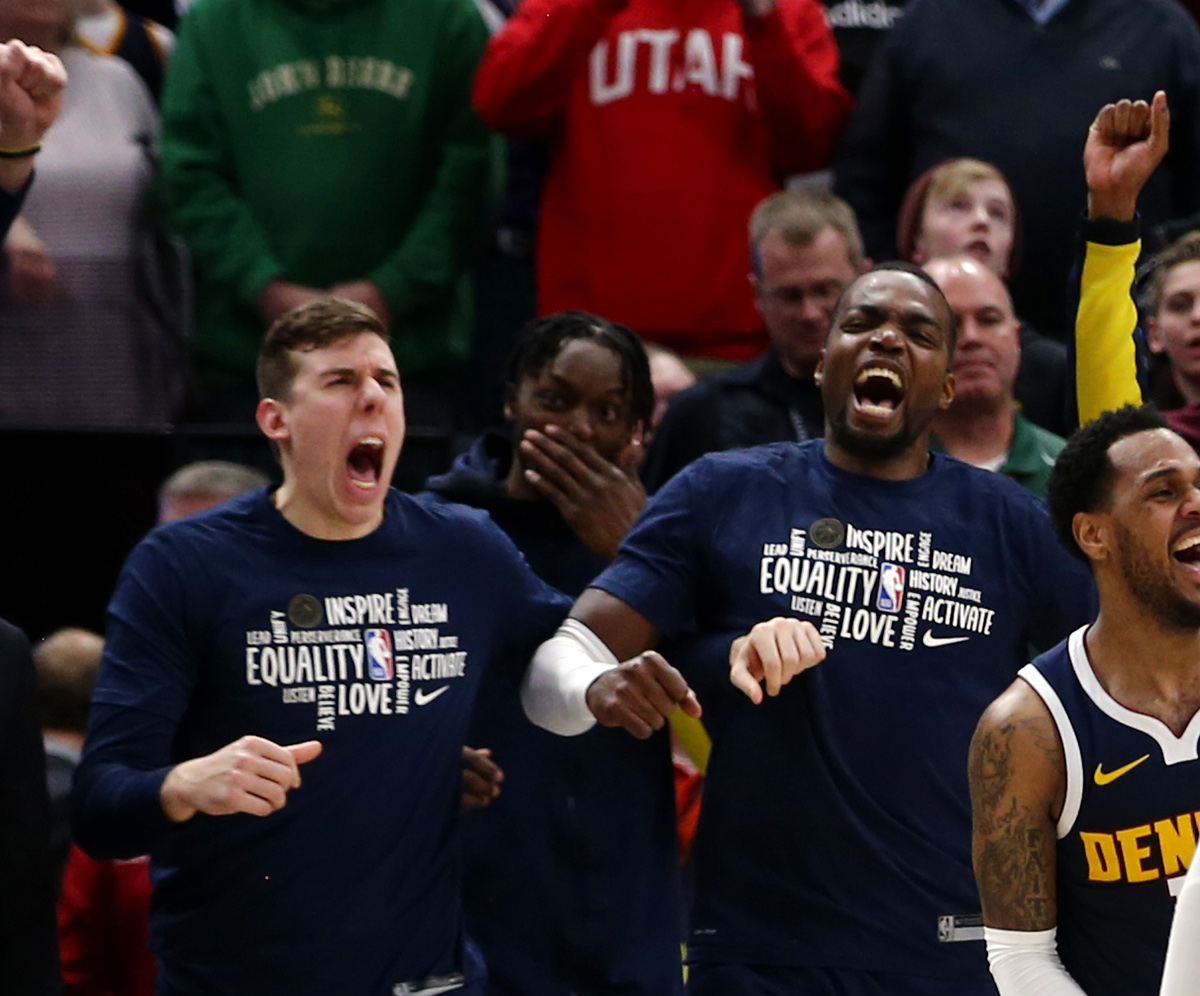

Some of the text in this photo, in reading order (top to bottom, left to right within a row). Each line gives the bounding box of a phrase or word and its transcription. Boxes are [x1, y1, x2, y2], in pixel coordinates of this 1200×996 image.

[763, 543, 788, 557] LEAD
[846, 523, 915, 563] INSPIRE
[932, 550, 971, 575] DREAM
[760, 557, 878, 607] EQUALITY
[909, 569, 958, 597] HISTORY
[325, 592, 396, 626] INSPIRE
[411, 603, 448, 624] DREAM
[791, 595, 823, 617] LISTEN
[899, 591, 922, 651] EMPOWER
[922, 596, 996, 635] ACTIVATE
[393, 628, 438, 651] HISTORY
[840, 607, 899, 648] LOVE
[246, 643, 364, 687] EQUALITY
[411, 651, 467, 681] ACTIVATE
[338, 682, 393, 715] LOVE
[395, 655, 410, 714] EMPOWER
[317, 685, 335, 731] BELIEVE
